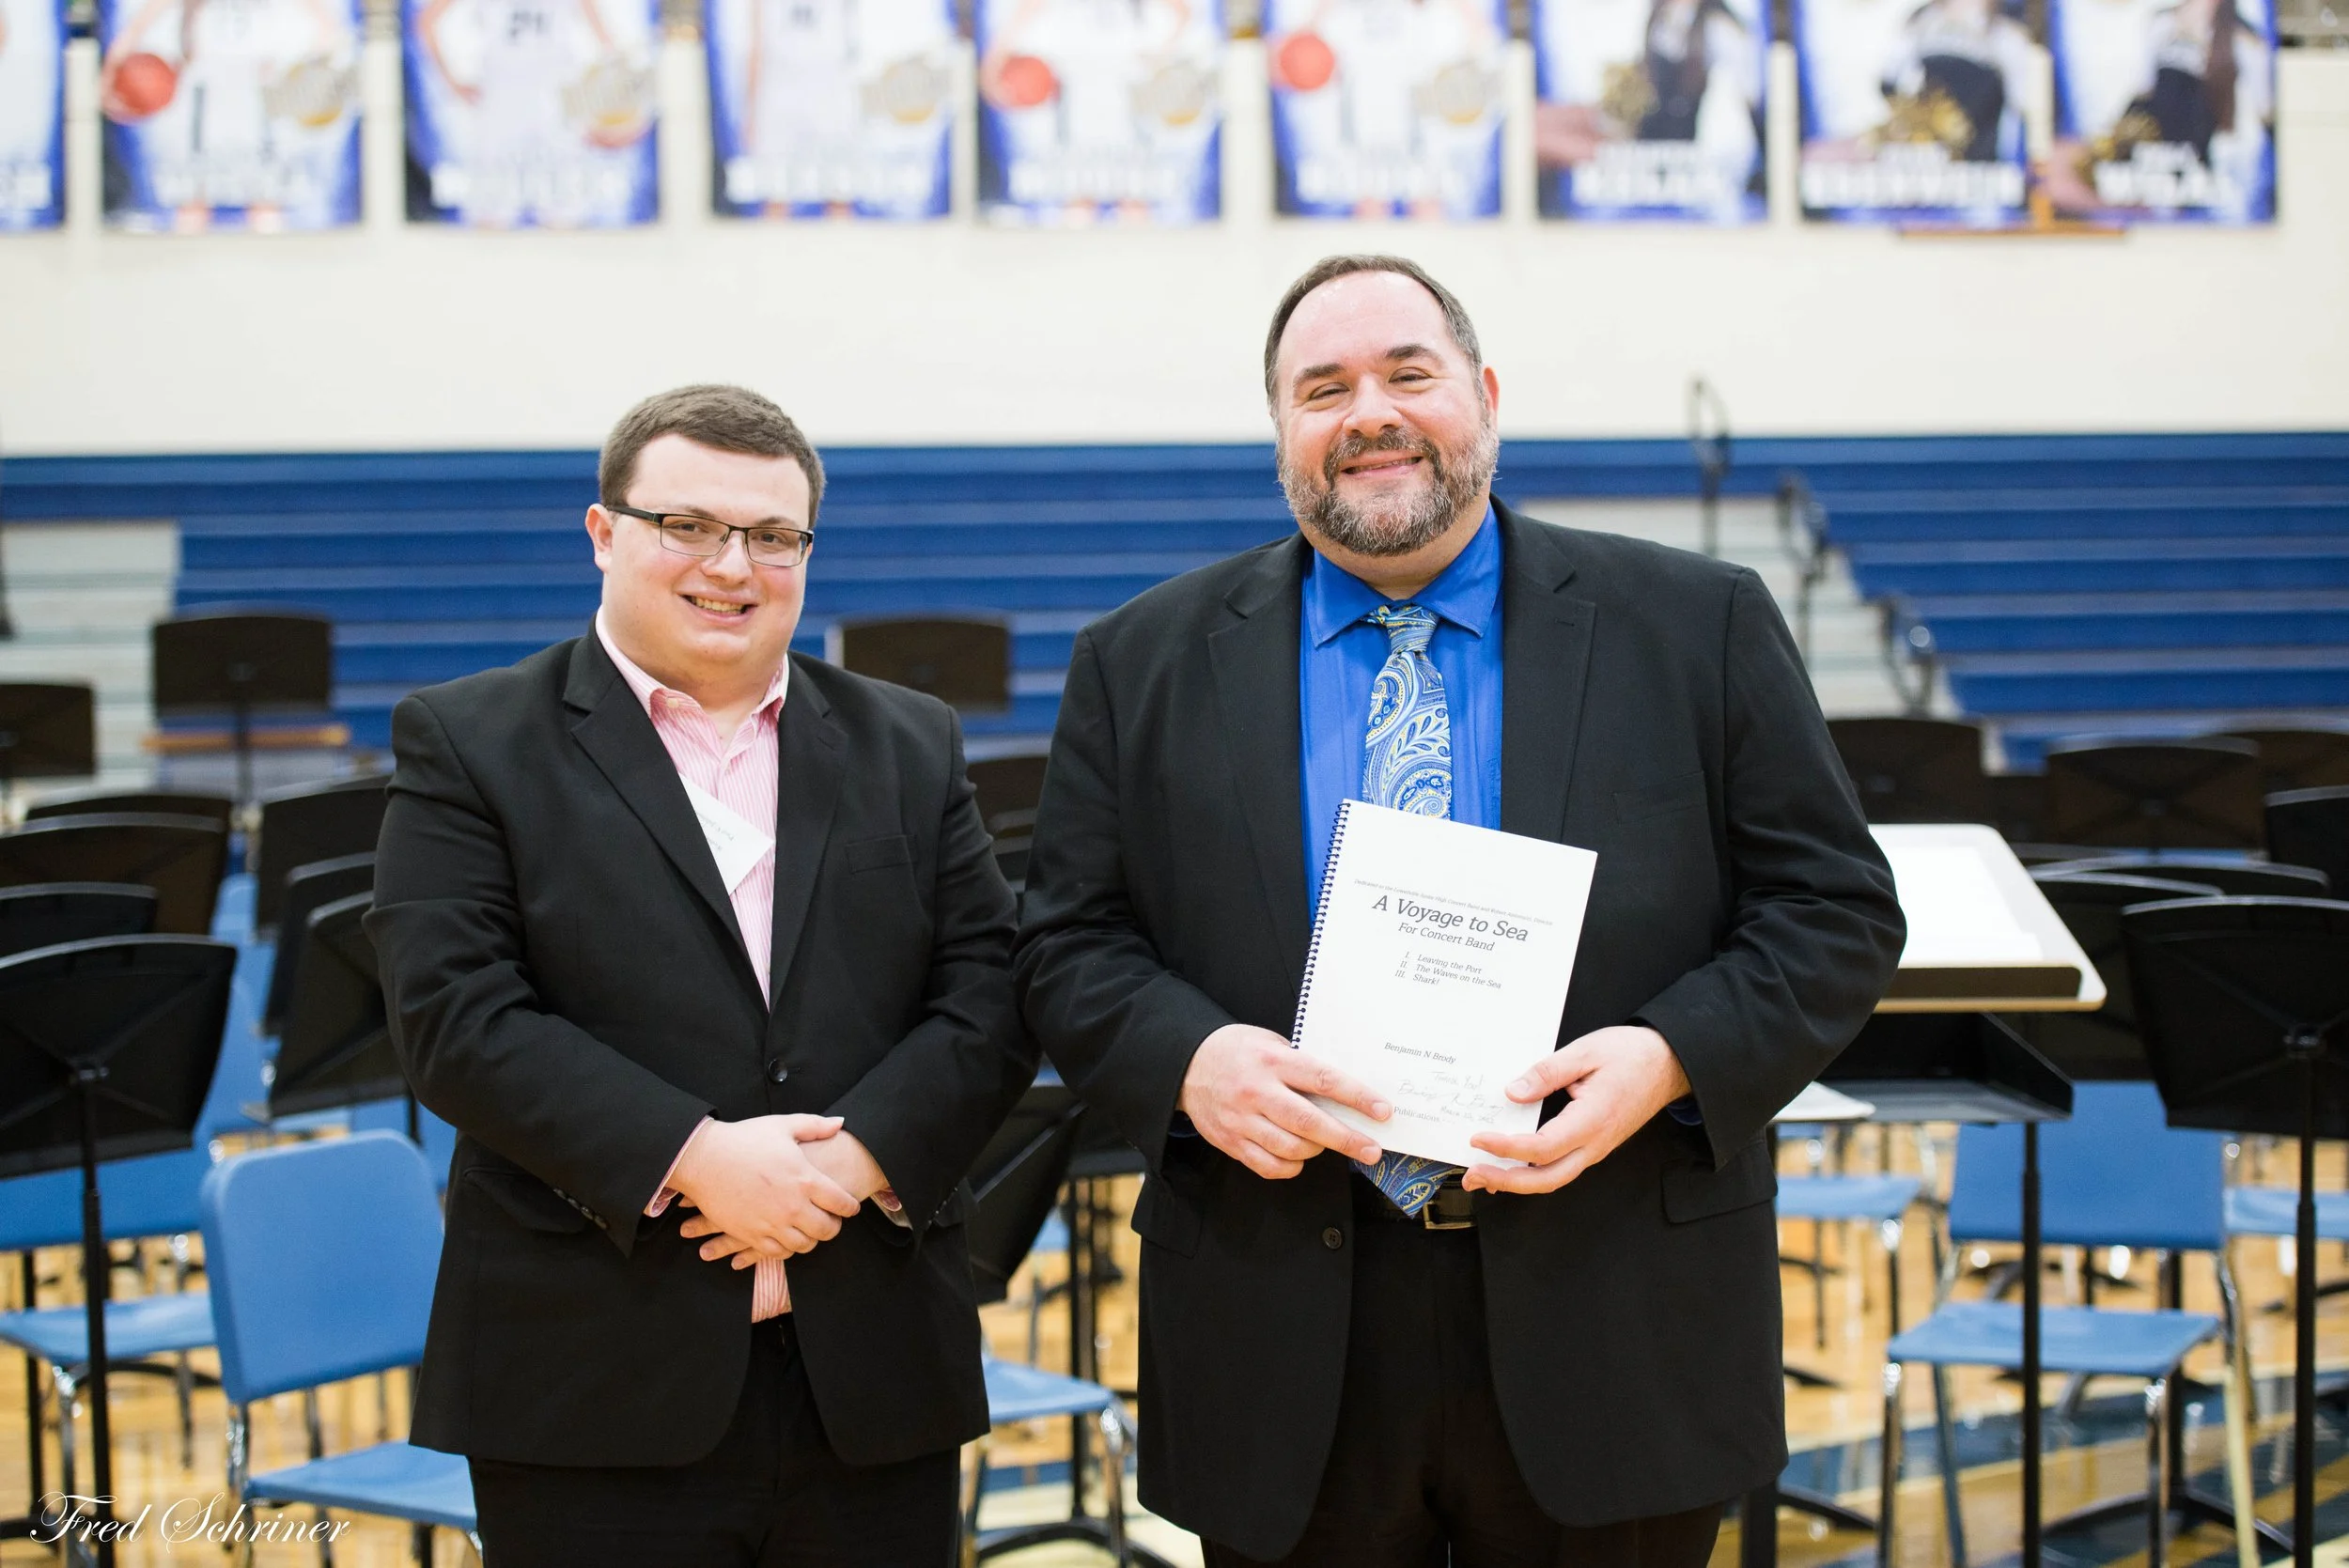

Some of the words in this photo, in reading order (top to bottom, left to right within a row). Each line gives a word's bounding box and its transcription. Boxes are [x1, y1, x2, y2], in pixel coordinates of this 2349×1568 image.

[1372, 894, 1389, 911] A
[1396, 897, 1464, 928] Voyage
[1469, 916, 1489, 932] to
[1493, 920, 1529, 941] Sea
[1397, 922, 1418, 934] For
[1420, 926, 1463, 944] Concert
[1465, 937, 1495, 951] Band
[1417, 954, 1448, 968] Leaving
[1450, 960, 1463, 970] the
[1465, 964, 1482, 974] Port
[1412, 973, 1439, 986] Shark!
[1415, 963, 1430, 973] The
[1433, 968, 1459, 980] Waves
[1458, 973, 1470, 982] on
[1471, 975, 1486, 986] the
[1486, 979, 1502, 988] Sea
[1384, 1042, 1422, 1057] Benjamin
[1423, 1049, 1431, 1058] N
[1432, 1052, 1455, 1064] Brody
[1393, 1106, 1439, 1122] Publications
